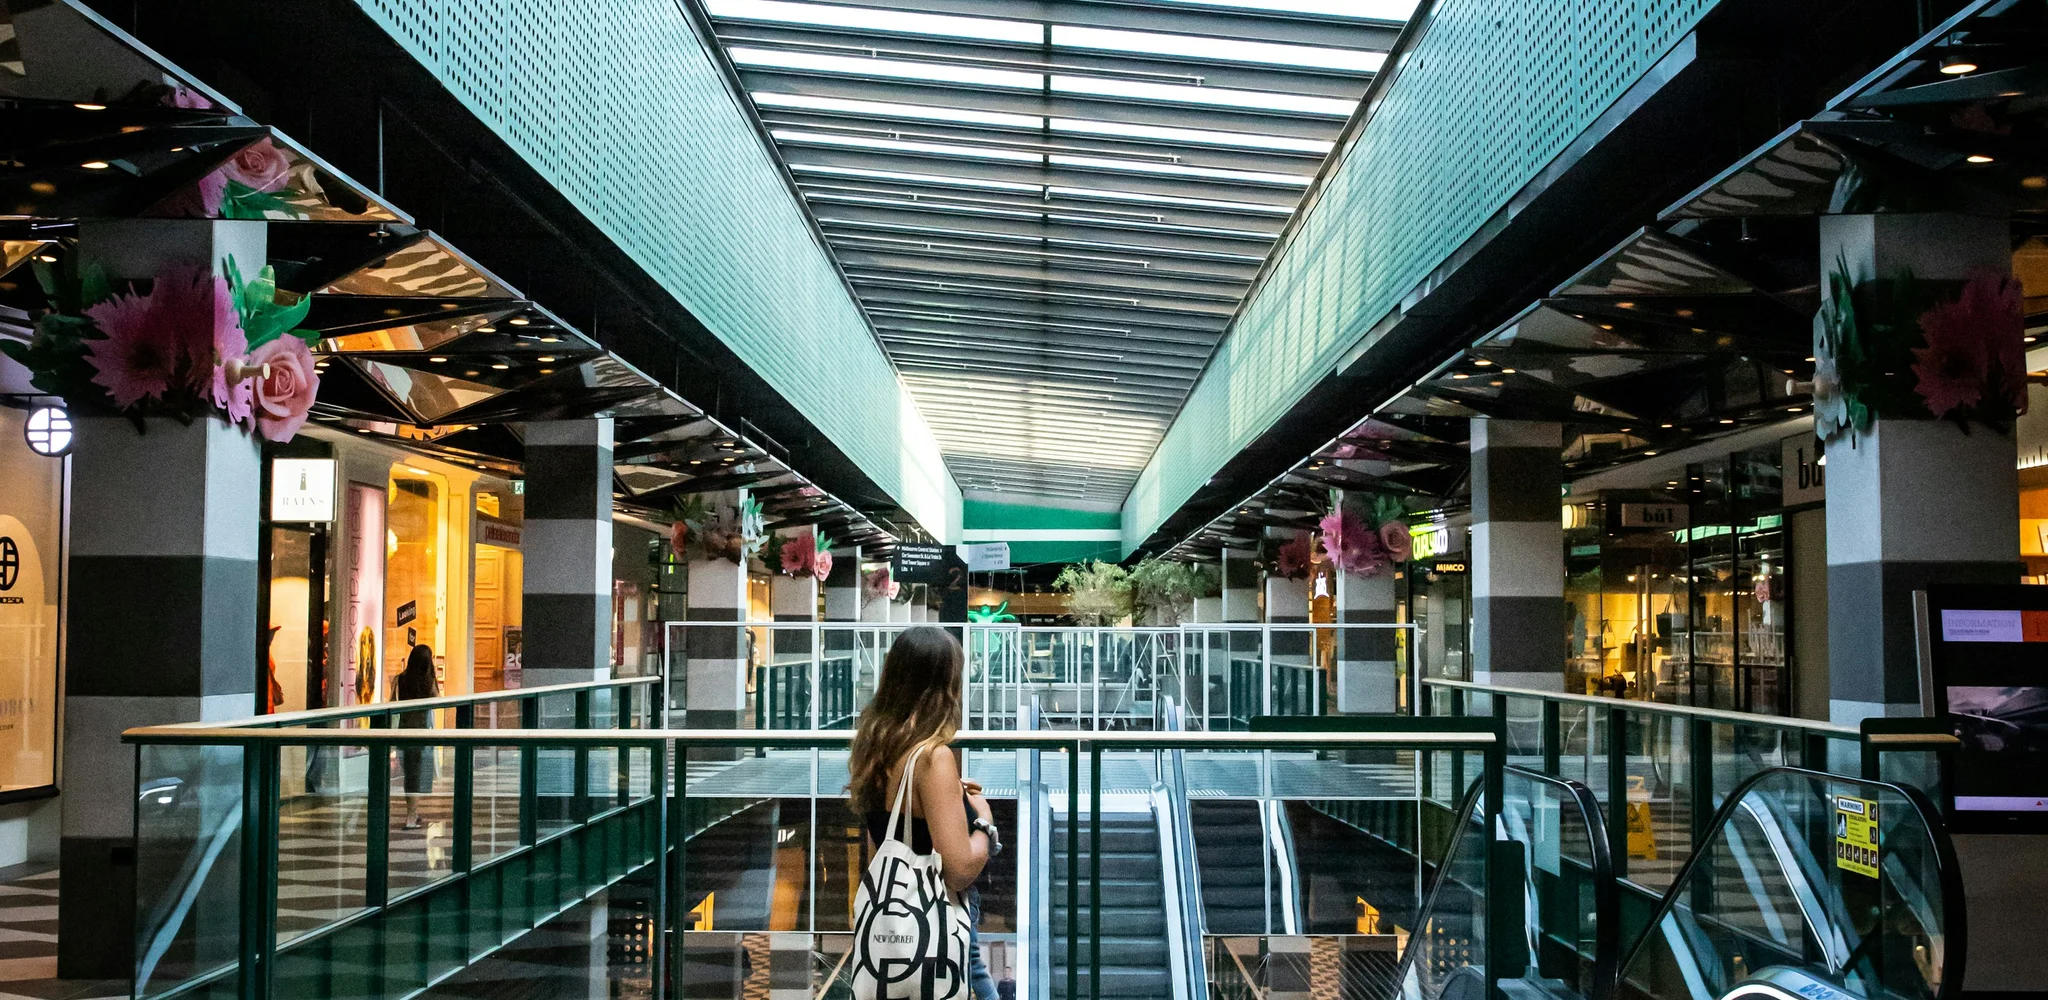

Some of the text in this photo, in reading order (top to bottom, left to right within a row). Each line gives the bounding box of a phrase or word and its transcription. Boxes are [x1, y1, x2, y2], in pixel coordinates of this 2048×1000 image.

[282, 497, 324, 506] RAINS
[1436, 563, 1465, 573] MIMCO
[1948, 619, 2016, 628] INFORMATION
[1840, 800, 1862, 812] WARNING
